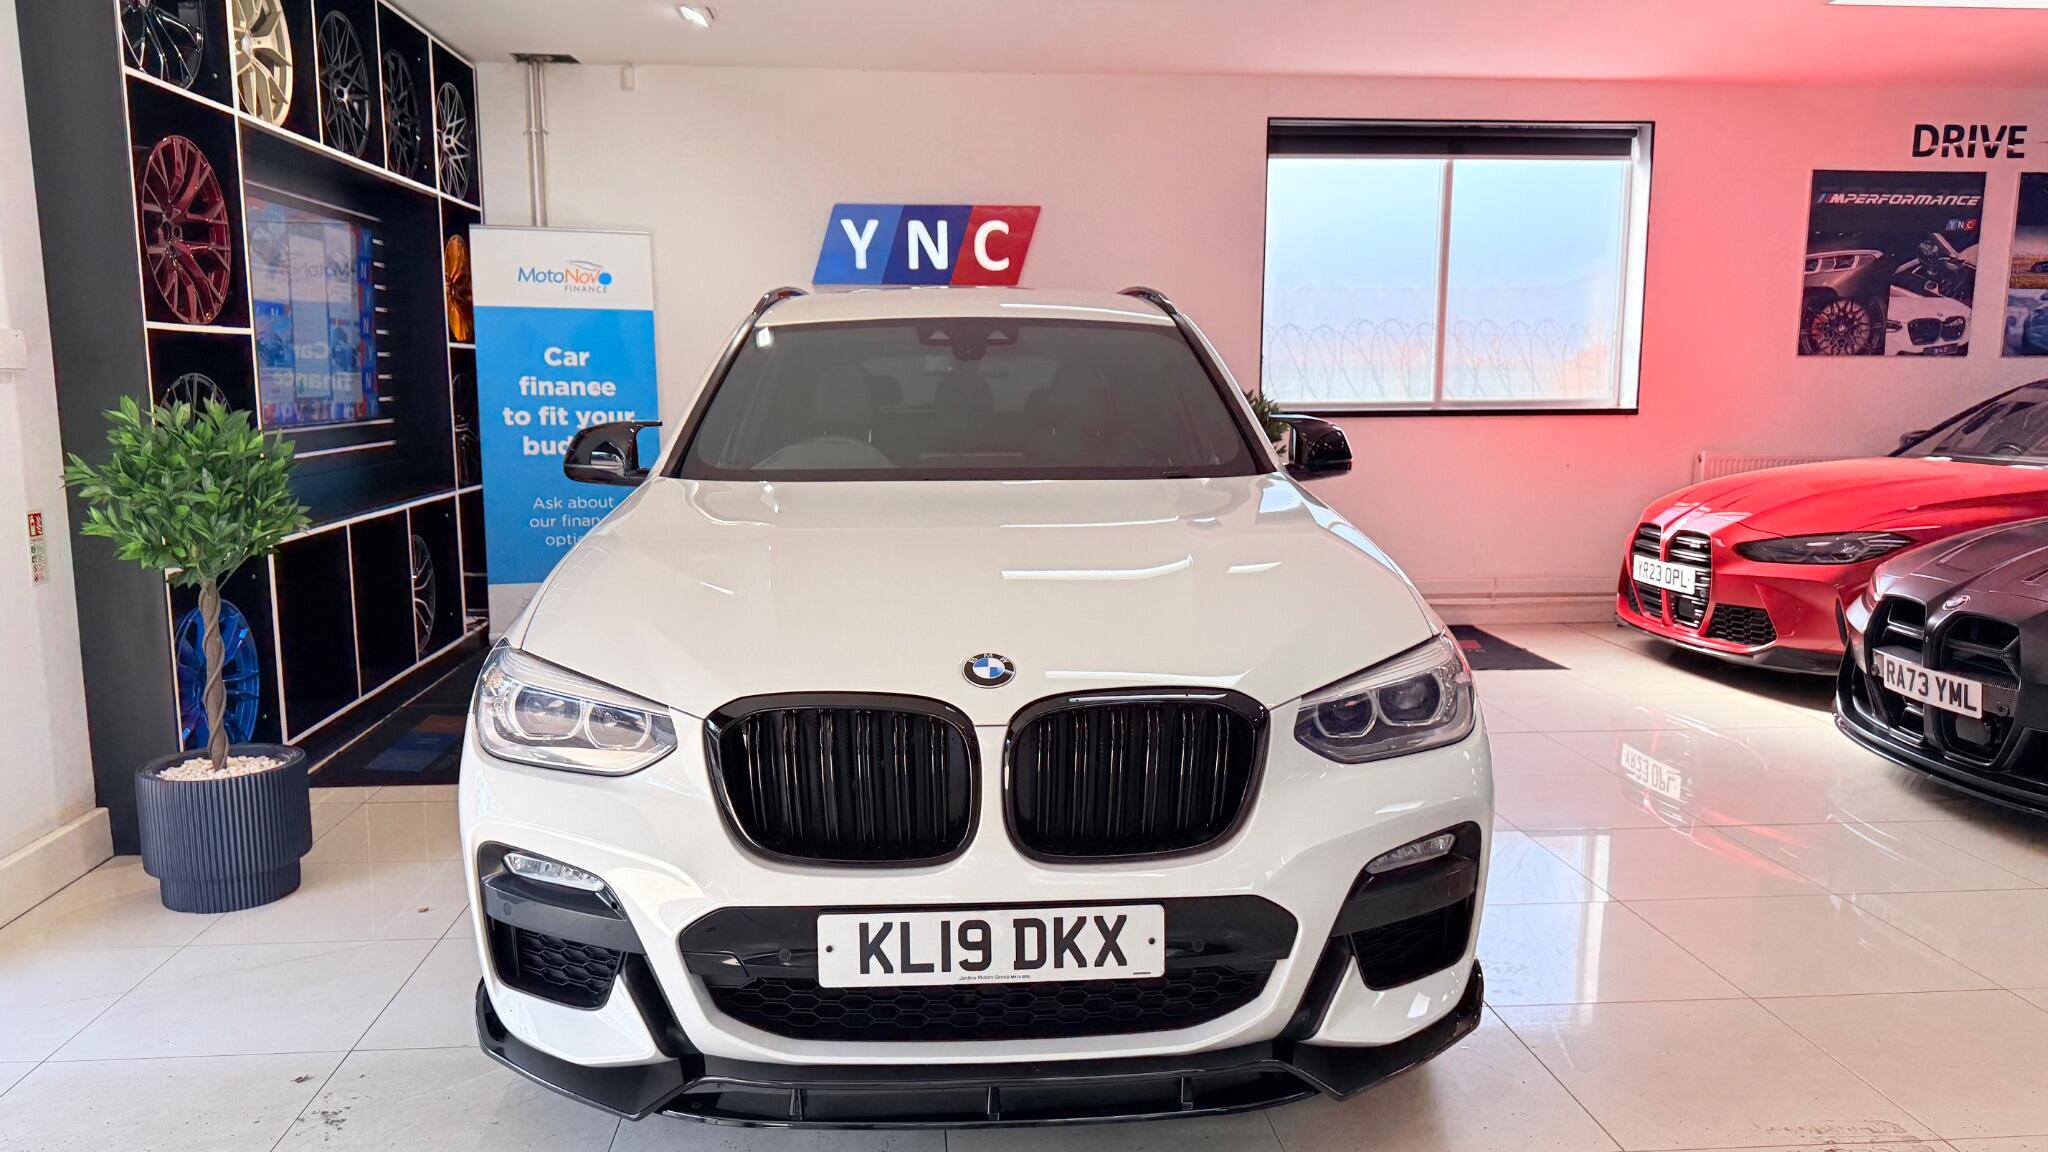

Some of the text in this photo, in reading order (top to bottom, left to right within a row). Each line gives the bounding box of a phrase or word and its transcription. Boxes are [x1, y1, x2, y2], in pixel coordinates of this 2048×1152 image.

[1912, 124, 2028, 158] DRIVE
[564, 285, 608, 294] FINANCE
[543, 346, 591, 367] Car
[519, 376, 617, 397] finance
[502, 406, 636, 430] to fit your
[533, 496, 615, 510] Ask about
[529, 514, 601, 528] our finan
[1637, 559, 1662, 582] YR23
[1886, 659, 1977, 712] RA73 YML
[858, 914, 1128, 975] KL19 DKX
